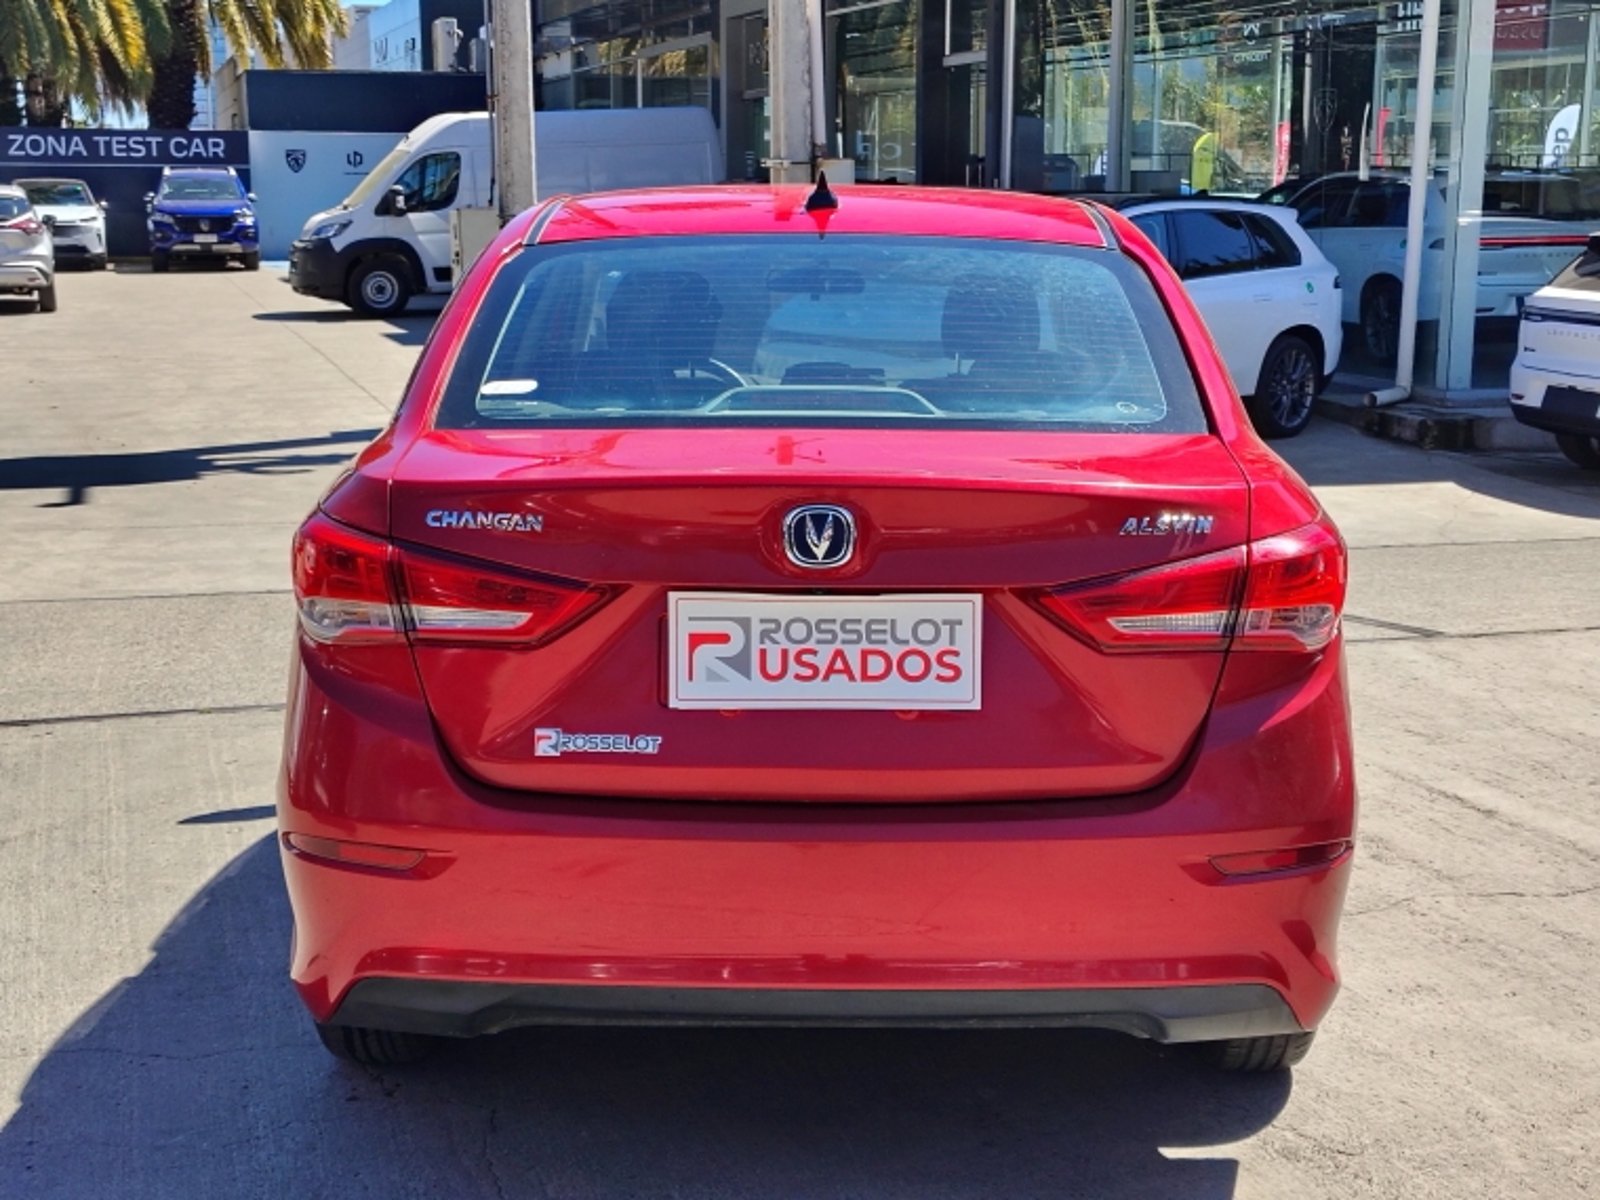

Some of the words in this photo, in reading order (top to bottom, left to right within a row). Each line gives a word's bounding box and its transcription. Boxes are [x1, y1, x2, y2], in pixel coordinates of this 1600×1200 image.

[7, 134, 88, 157] ZONA
[93, 136, 163, 158] TEST
[169, 136, 226, 159] CAR
[426, 509, 544, 532] CHANGAN
[1119, 513, 1214, 535] ALSVIN
[759, 616, 963, 647] ROSSELOT
[759, 648, 963, 684] USADOS
[560, 733, 661, 753] ROSSELOT
